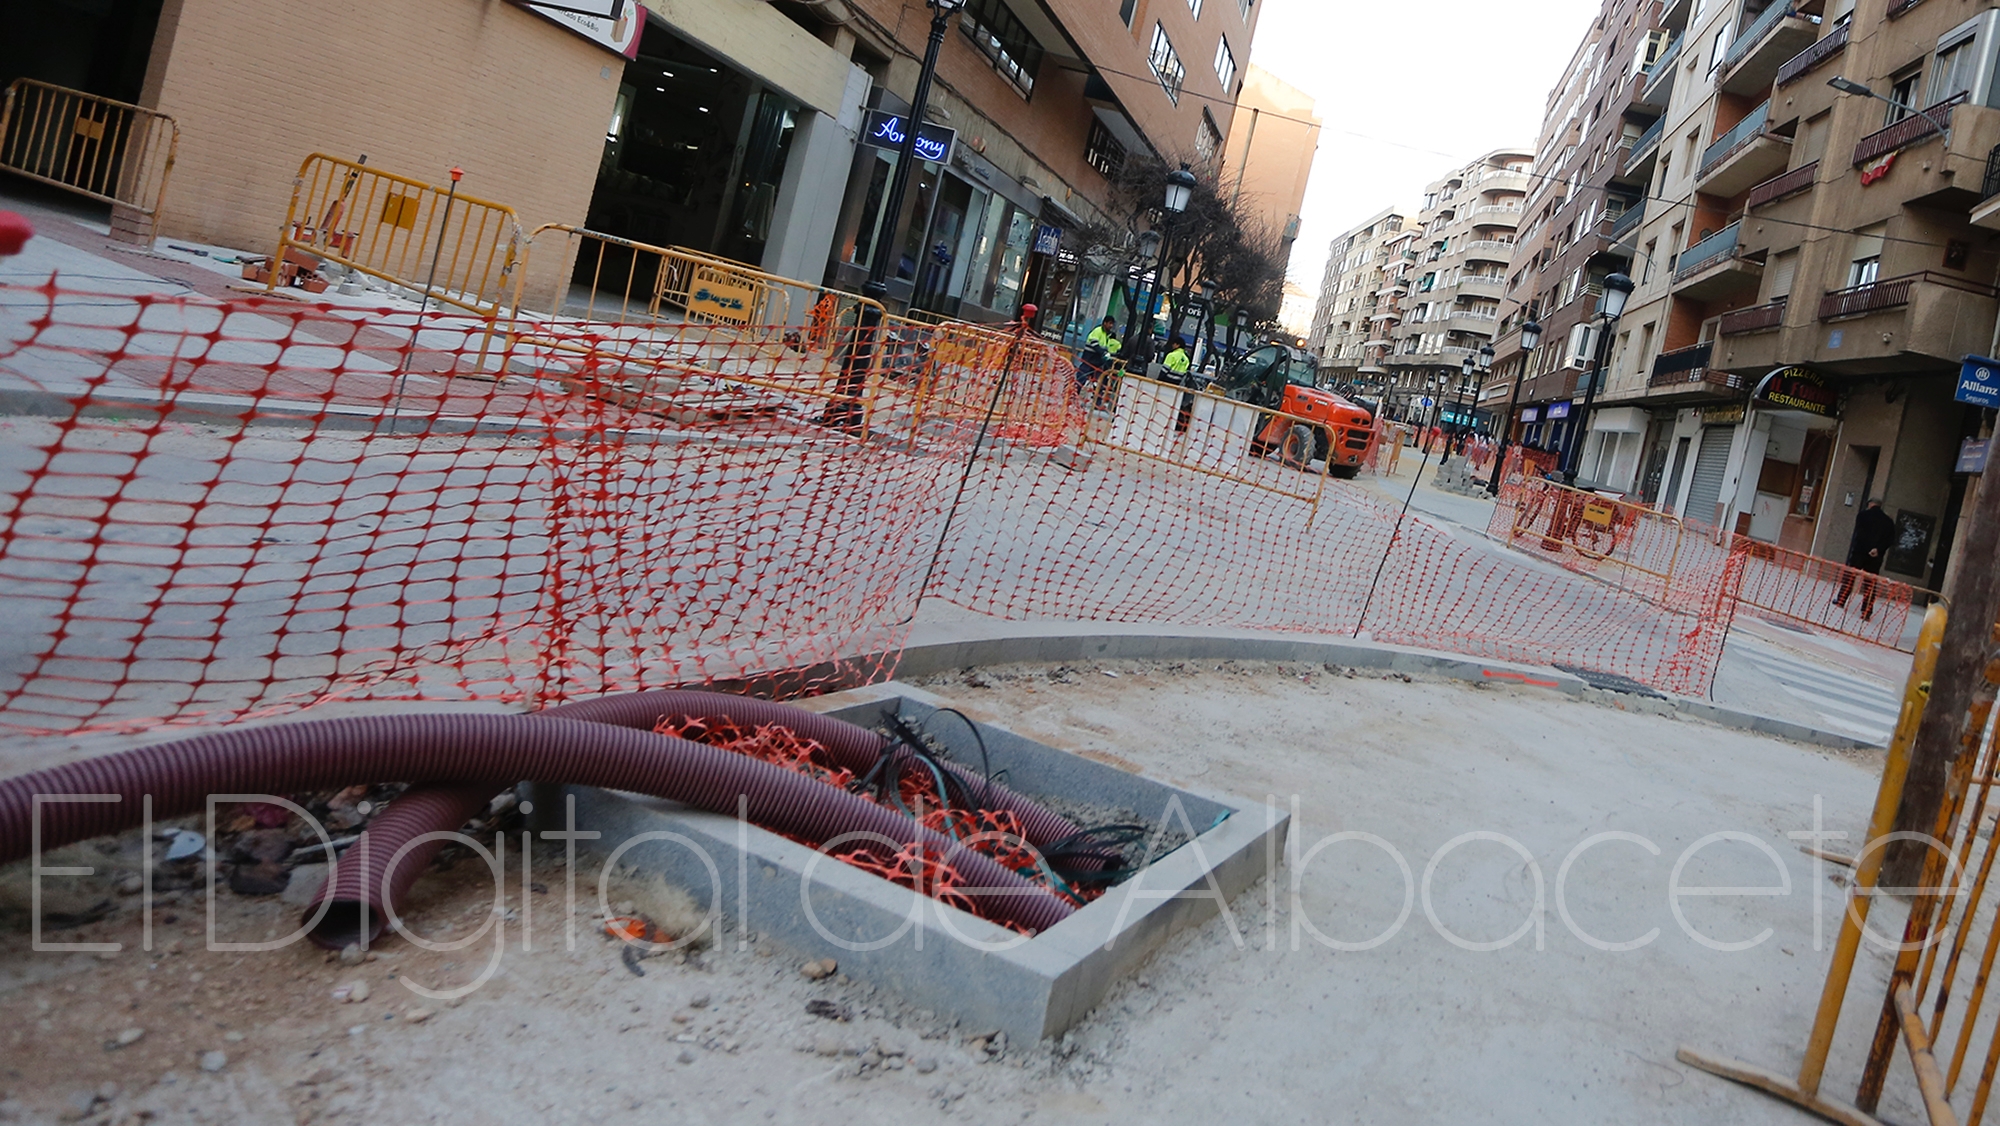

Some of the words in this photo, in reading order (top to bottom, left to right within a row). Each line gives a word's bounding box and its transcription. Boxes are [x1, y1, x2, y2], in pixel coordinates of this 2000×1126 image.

[873, 116, 945, 160] Anony
[1769, 377, 1784, 393] IL
[1783, 367, 1825, 387] PIZZERIA
[1961, 380, 1999, 396] Allianz
[1768, 391, 1827, 414] RESTAURANTE
